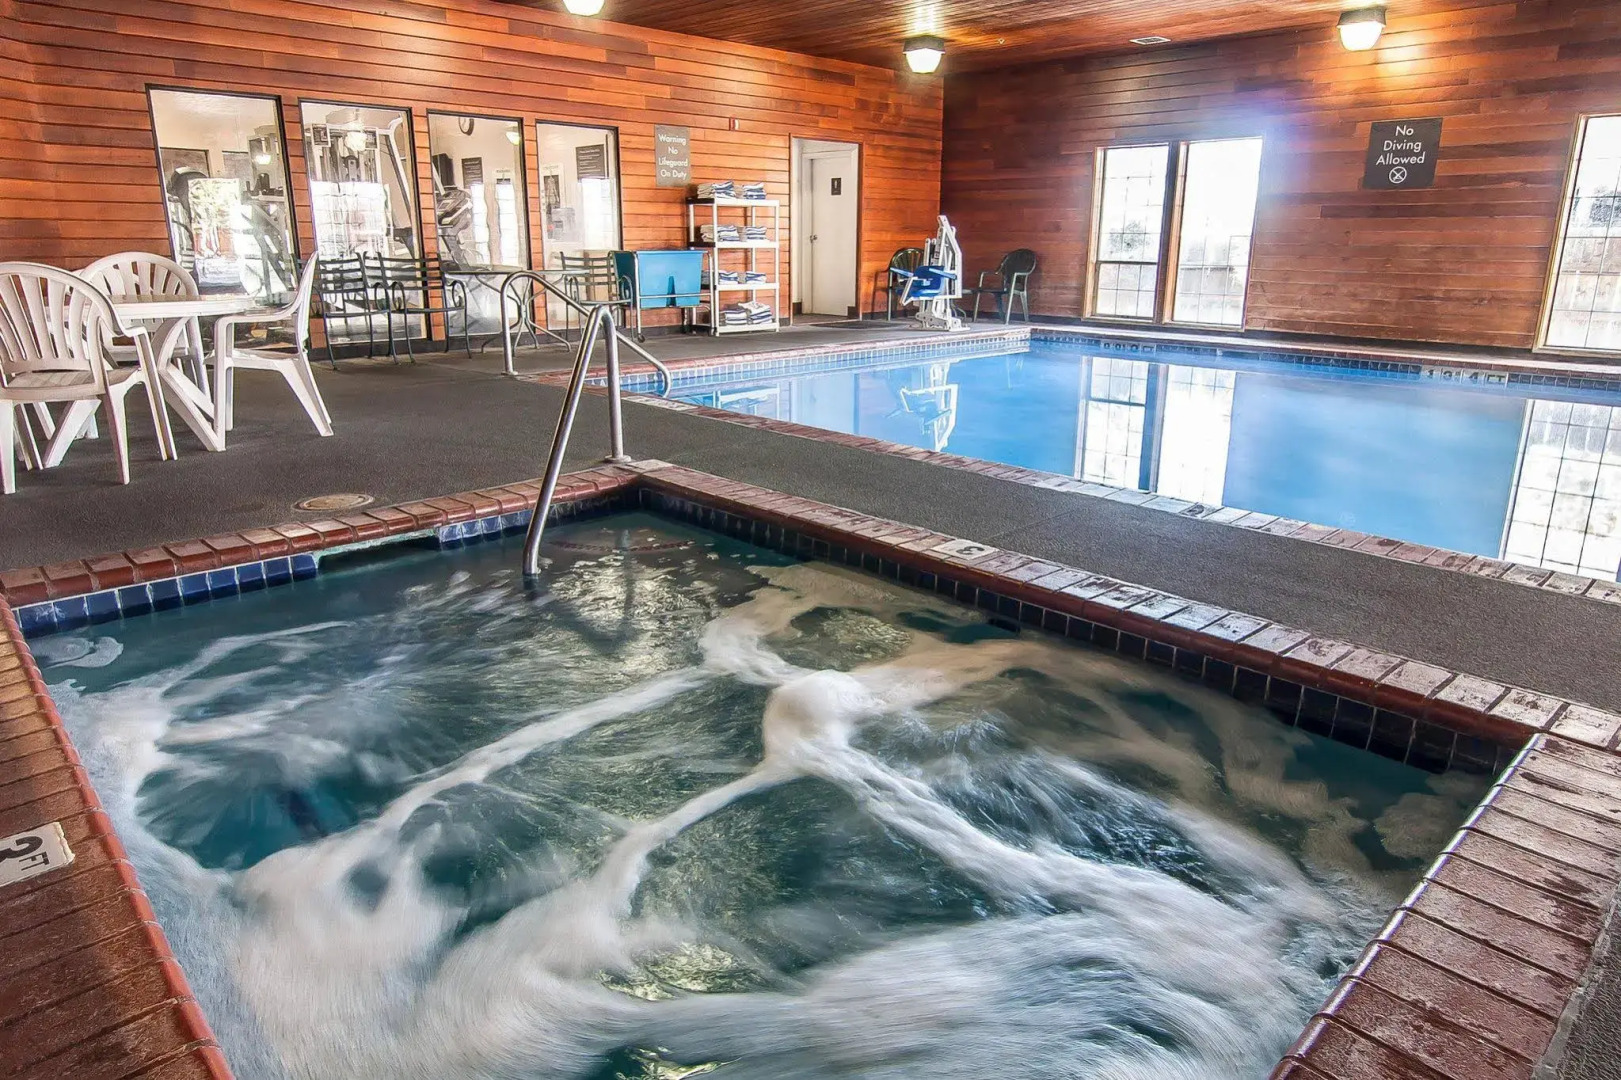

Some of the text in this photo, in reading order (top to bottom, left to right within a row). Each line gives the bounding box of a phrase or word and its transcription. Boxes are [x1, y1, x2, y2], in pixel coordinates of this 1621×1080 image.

[1395, 125, 1414, 136] No
[658, 133, 687, 146] Warning
[667, 146, 679, 155] No
[1383, 139, 1422, 153] Diving
[658, 156, 689, 168] Lifeguard
[1375, 151, 1426, 166] Allowed
[660, 169, 688, 180] On Duty
